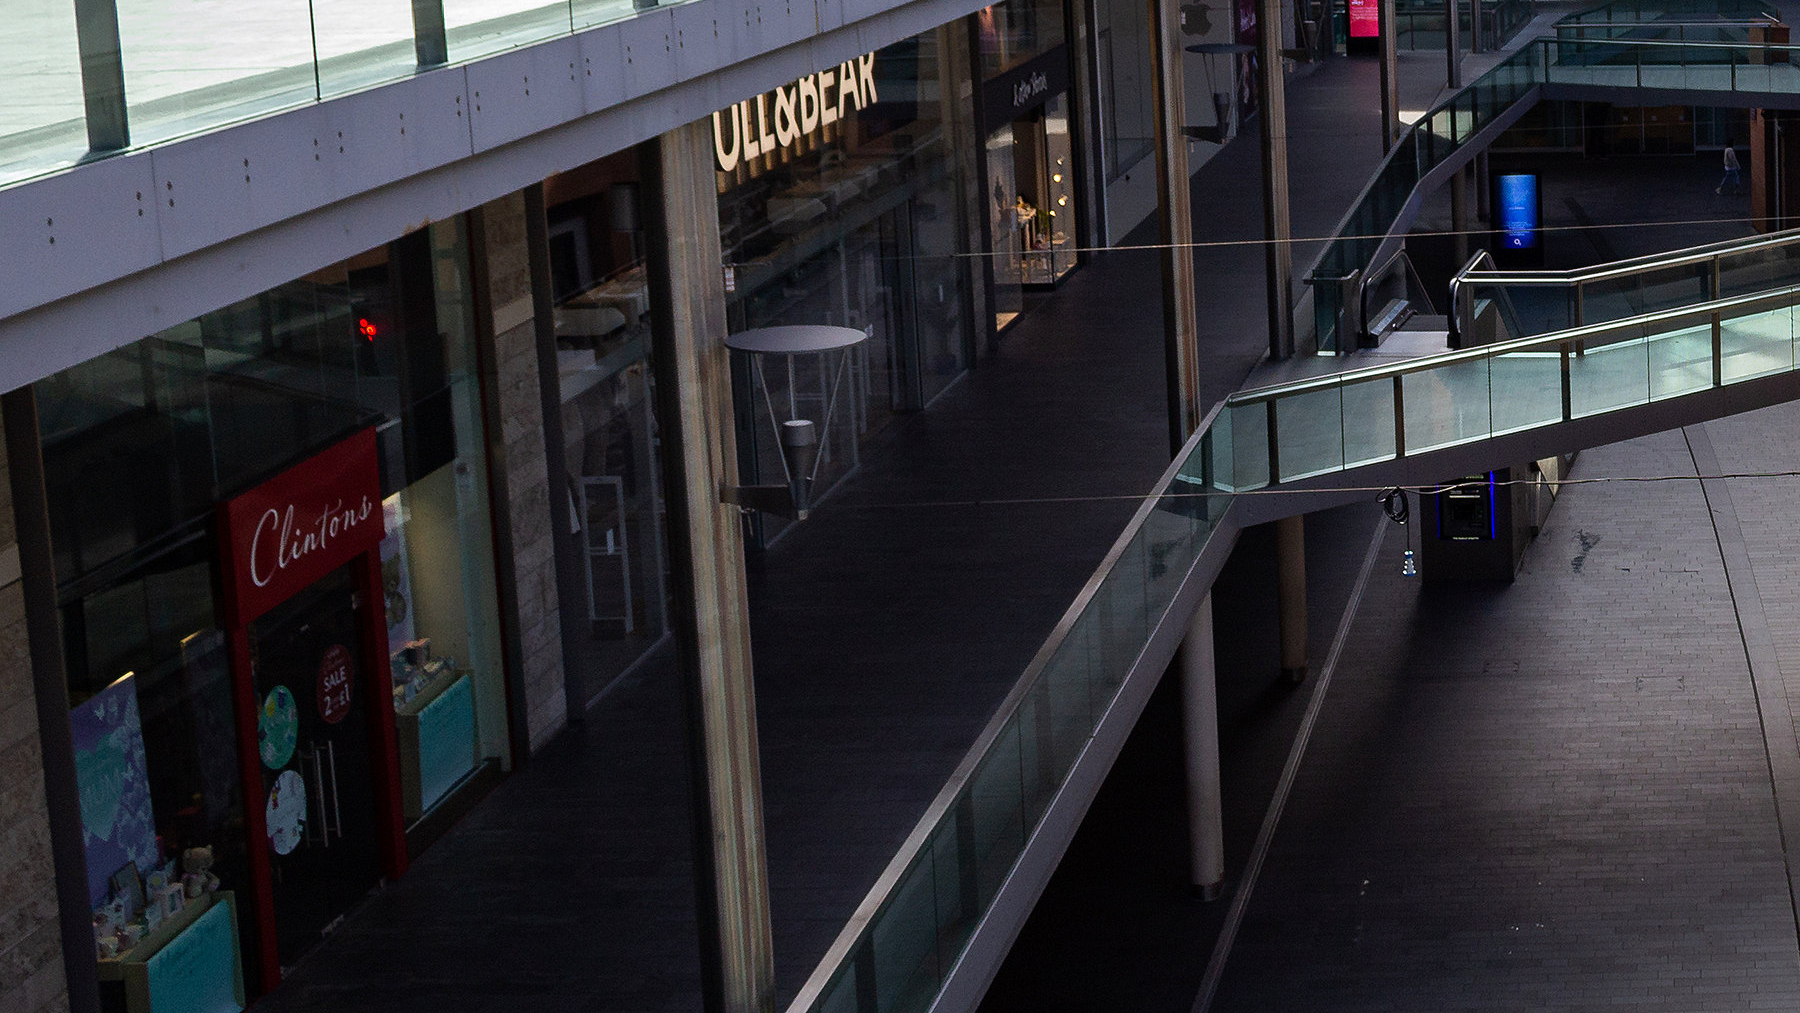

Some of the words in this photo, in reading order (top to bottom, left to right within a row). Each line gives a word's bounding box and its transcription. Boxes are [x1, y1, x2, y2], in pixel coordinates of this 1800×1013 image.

[251, 495, 372, 587] Clintons
[324, 666, 346, 692] SALE
[324, 696, 333, 717] 2
